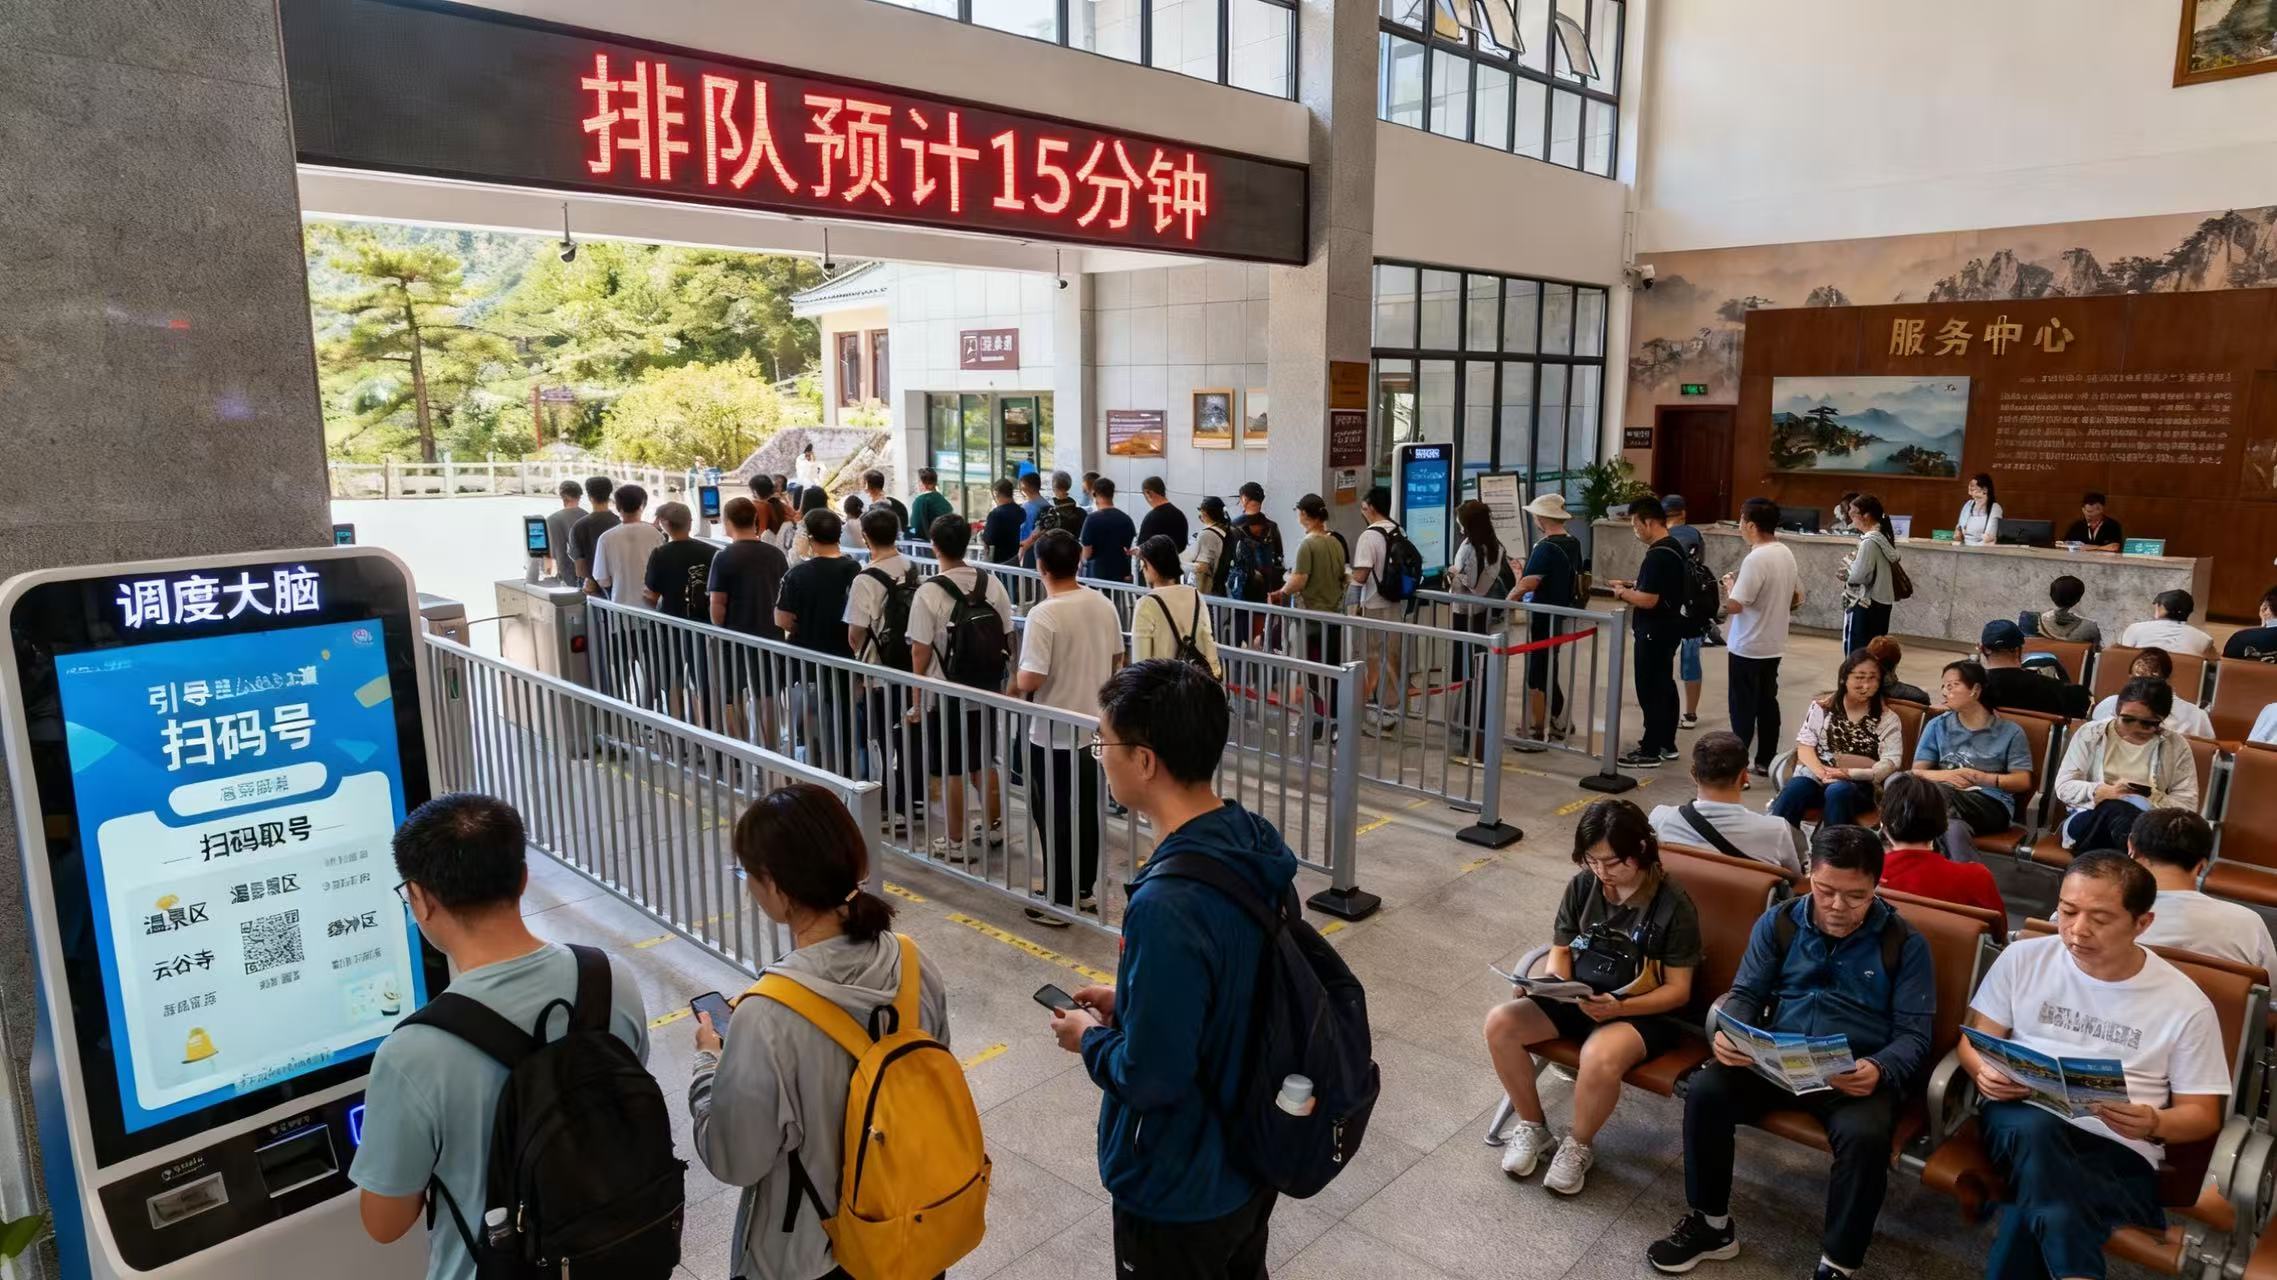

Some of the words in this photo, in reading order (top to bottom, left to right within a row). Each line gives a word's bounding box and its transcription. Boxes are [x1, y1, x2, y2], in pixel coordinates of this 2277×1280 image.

[581, 54, 1208, 240] 排队预计15分钟
[1888, 315, 2075, 356] 服务中心
[116, 565, 320, 629] 调度大脑
[161, 703, 316, 772] 扫码号
[200, 815, 312, 862] 扫码取号
[153, 948, 215, 981] 云谷寺
